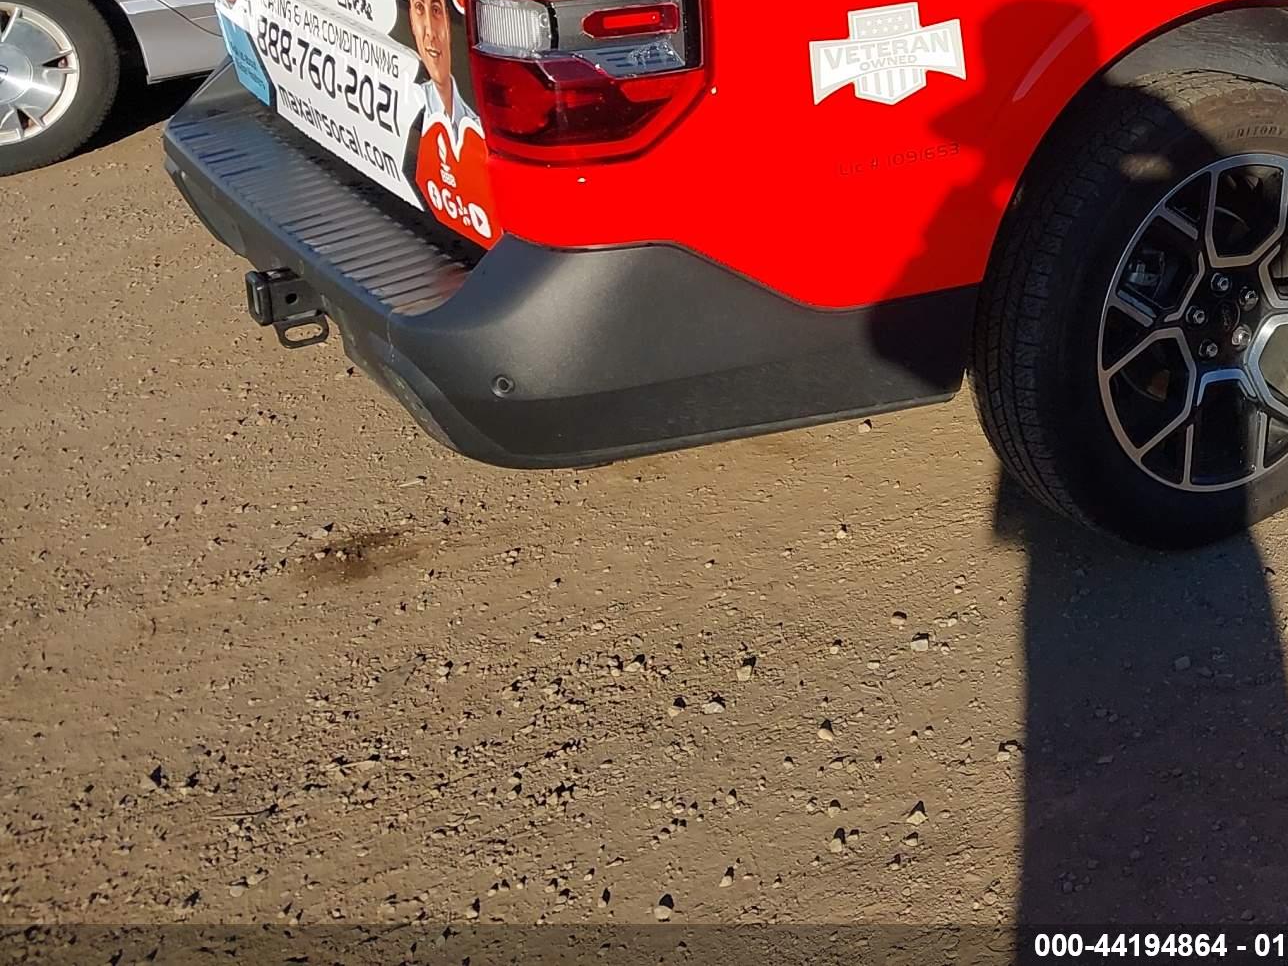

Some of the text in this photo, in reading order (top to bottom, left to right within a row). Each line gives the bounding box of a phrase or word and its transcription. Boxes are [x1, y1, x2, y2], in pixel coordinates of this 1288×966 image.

[256, 14, 401, 138] 888-760-2021
[293, 5, 301, 27] &
[302, 10, 320, 34] AIR
[321, 20, 399, 79] CONDITIONING
[823, 29, 950, 70] VETERAN
[858, 54, 918, 71] OWNED
[277, 83, 401, 181] maxairsocal.com
